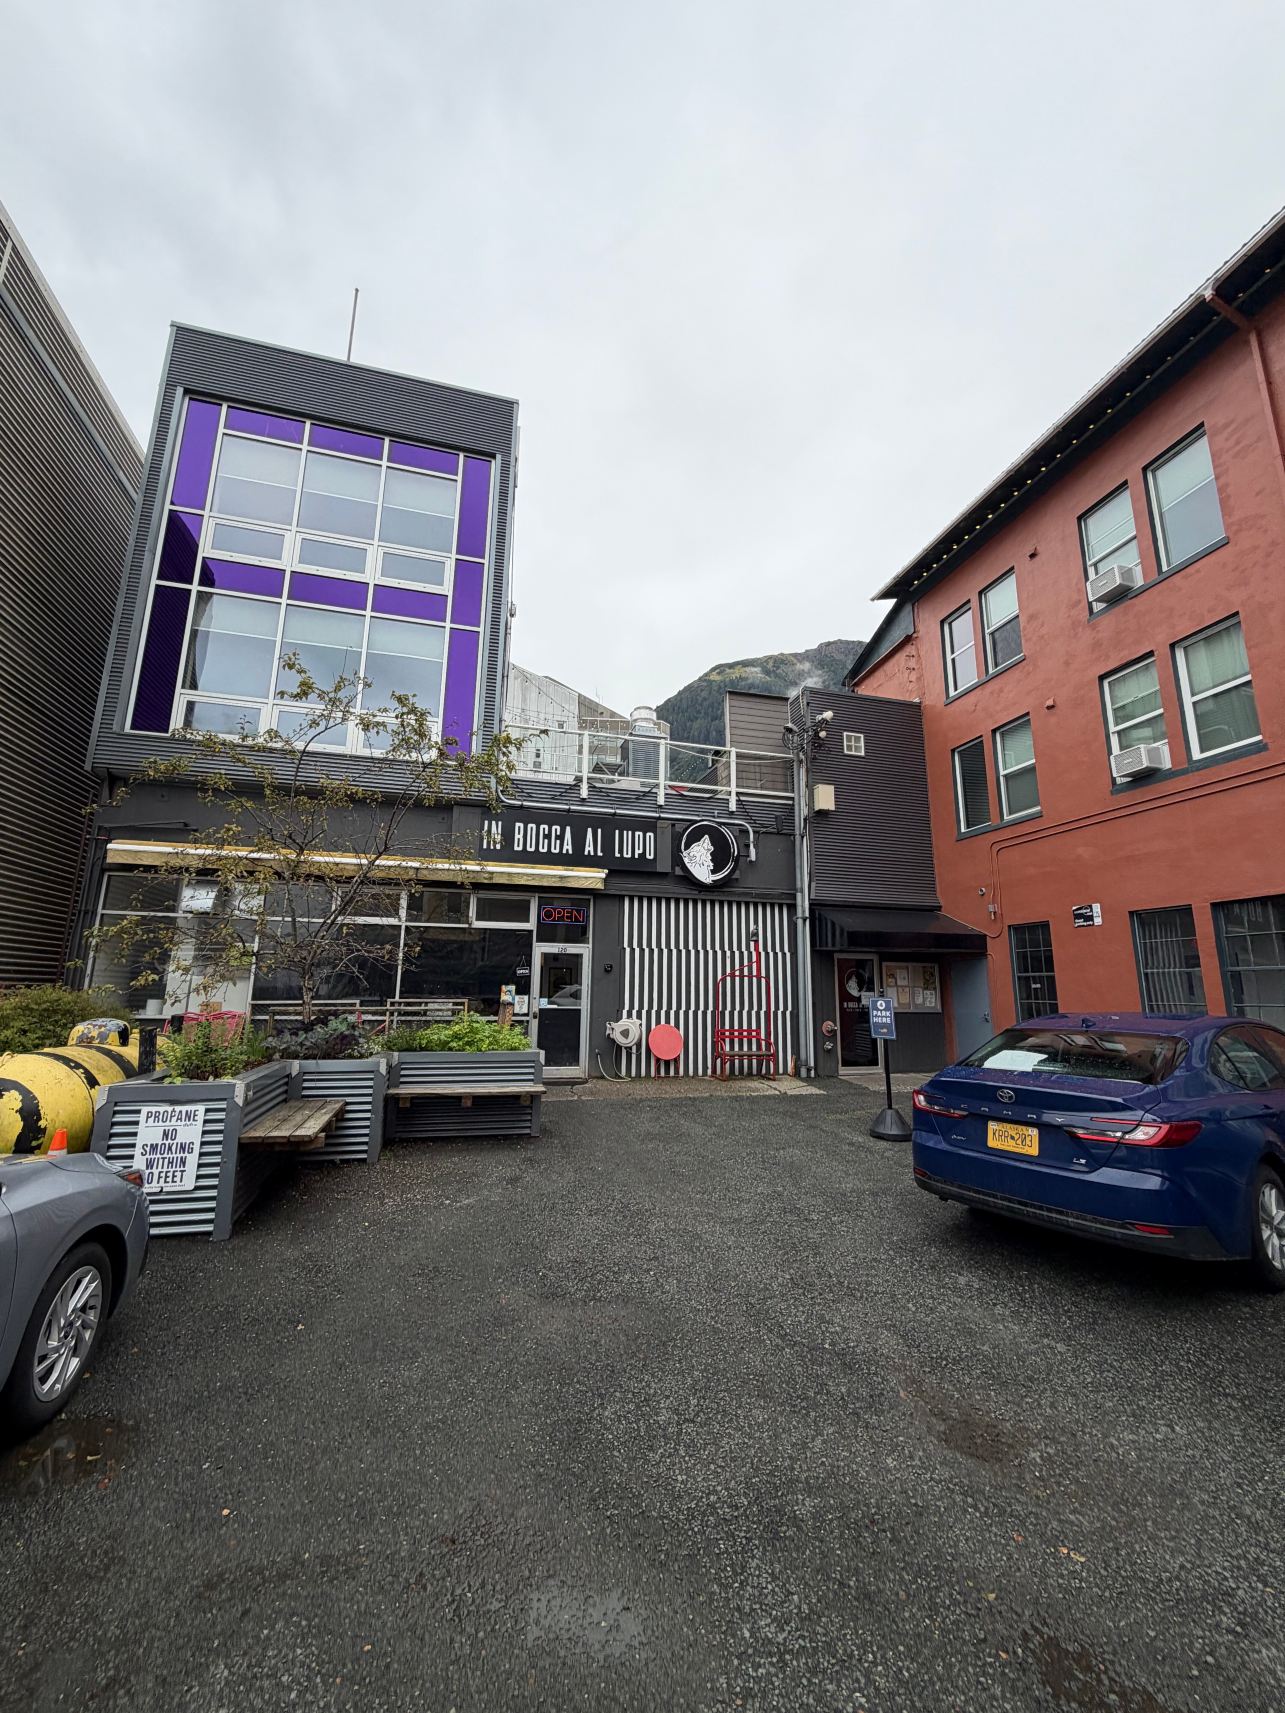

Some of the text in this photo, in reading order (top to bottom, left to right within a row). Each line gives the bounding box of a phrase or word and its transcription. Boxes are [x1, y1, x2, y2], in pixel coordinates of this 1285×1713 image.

[482, 820, 655, 860] IN BOCCA AL LUPO
[542, 907, 584, 922] OPEN
[145, 1109, 199, 1124] PROPANE
[161, 1128, 178, 1142] NO
[992, 1128, 1010, 1144] KRR
[140, 1141, 195, 1156] SMOKING
[145, 1156, 187, 1170] WITHIN
[157, 1170, 186, 1185] FEET
